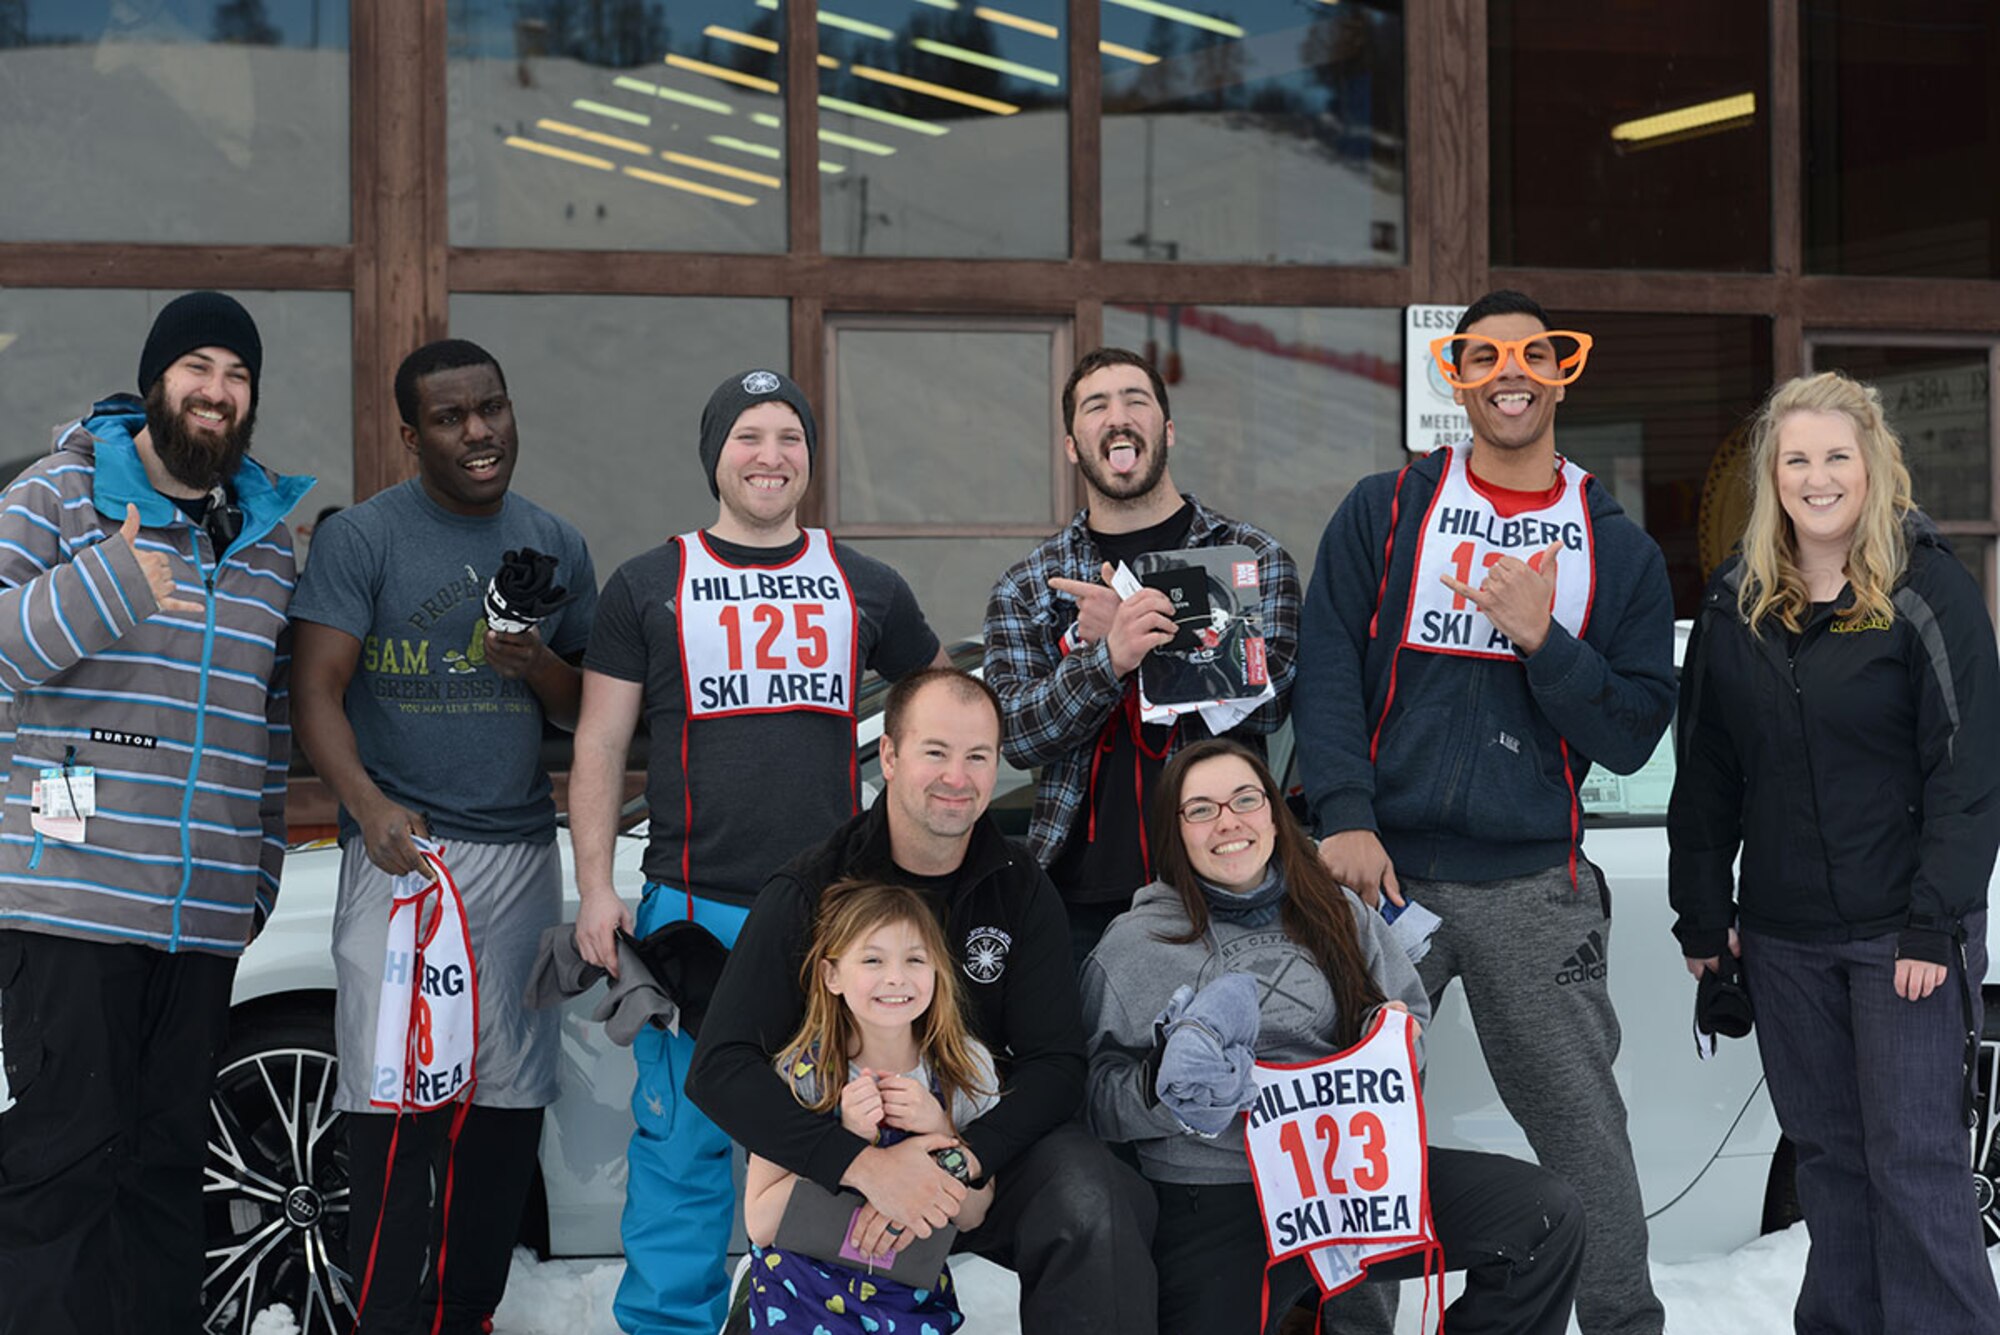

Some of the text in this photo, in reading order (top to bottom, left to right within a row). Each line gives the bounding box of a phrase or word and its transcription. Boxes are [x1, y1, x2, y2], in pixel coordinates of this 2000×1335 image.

[1438, 507, 1583, 551] HILLBERG
[408, 575, 488, 633] PROPE
[691, 573, 840, 601] HILLBERG
[719, 603, 828, 670] 125
[1420, 610, 1473, 645] SKI
[363, 635, 430, 675] SAM
[700, 673, 844, 709] SKI AREA
[94, 731, 152, 747] BURTON
[1555, 962, 1607, 985] adid
[1249, 1068, 1405, 1128] HILLBERG
[1280, 1111, 1389, 1199] 123
[1276, 1195, 1411, 1246] SKI AREA
